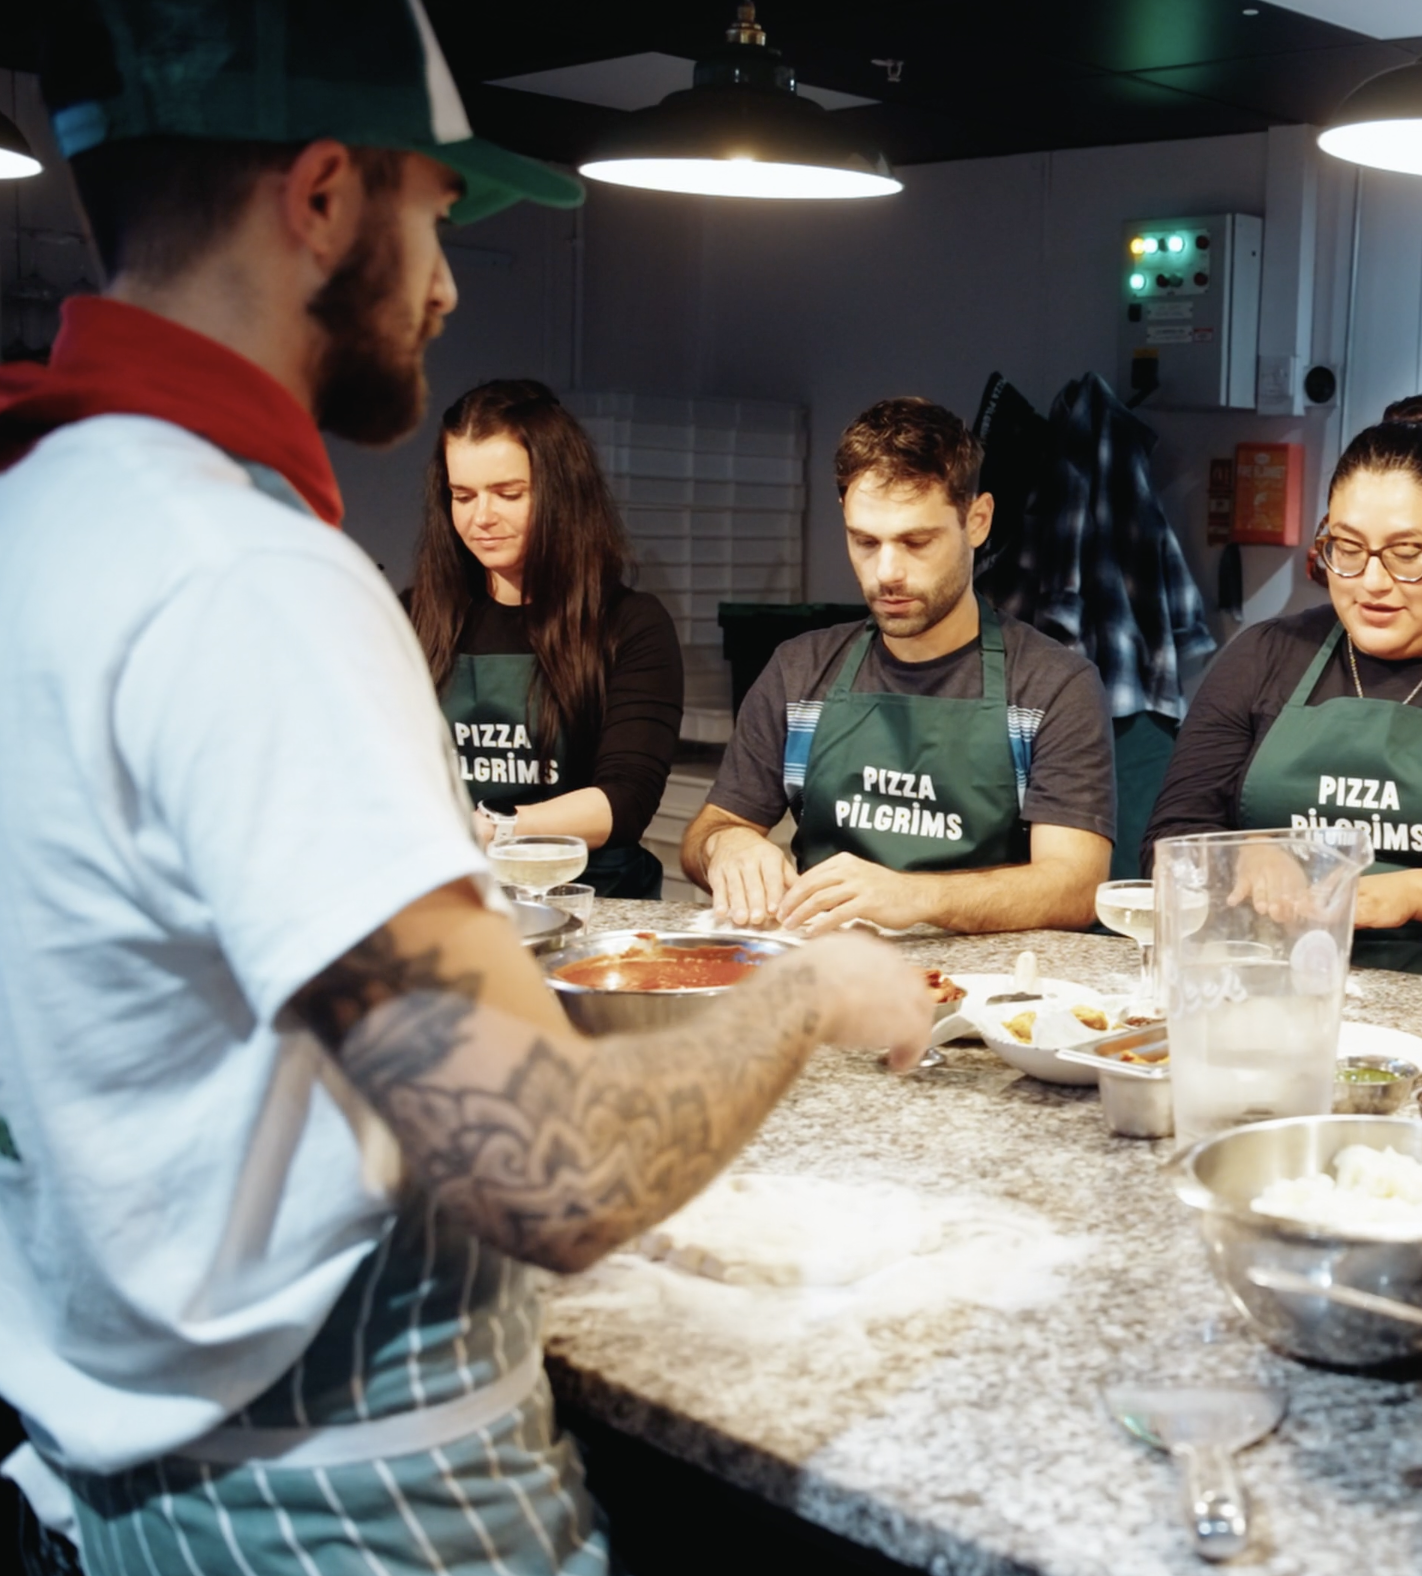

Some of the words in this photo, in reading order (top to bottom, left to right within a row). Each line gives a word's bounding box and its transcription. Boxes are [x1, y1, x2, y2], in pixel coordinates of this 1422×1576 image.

[454, 722, 532, 749] PIZZA
[459, 751, 559, 785] LGRiMS
[863, 765, 937, 801] PIZZA
[1318, 774, 1400, 811] PIZZA
